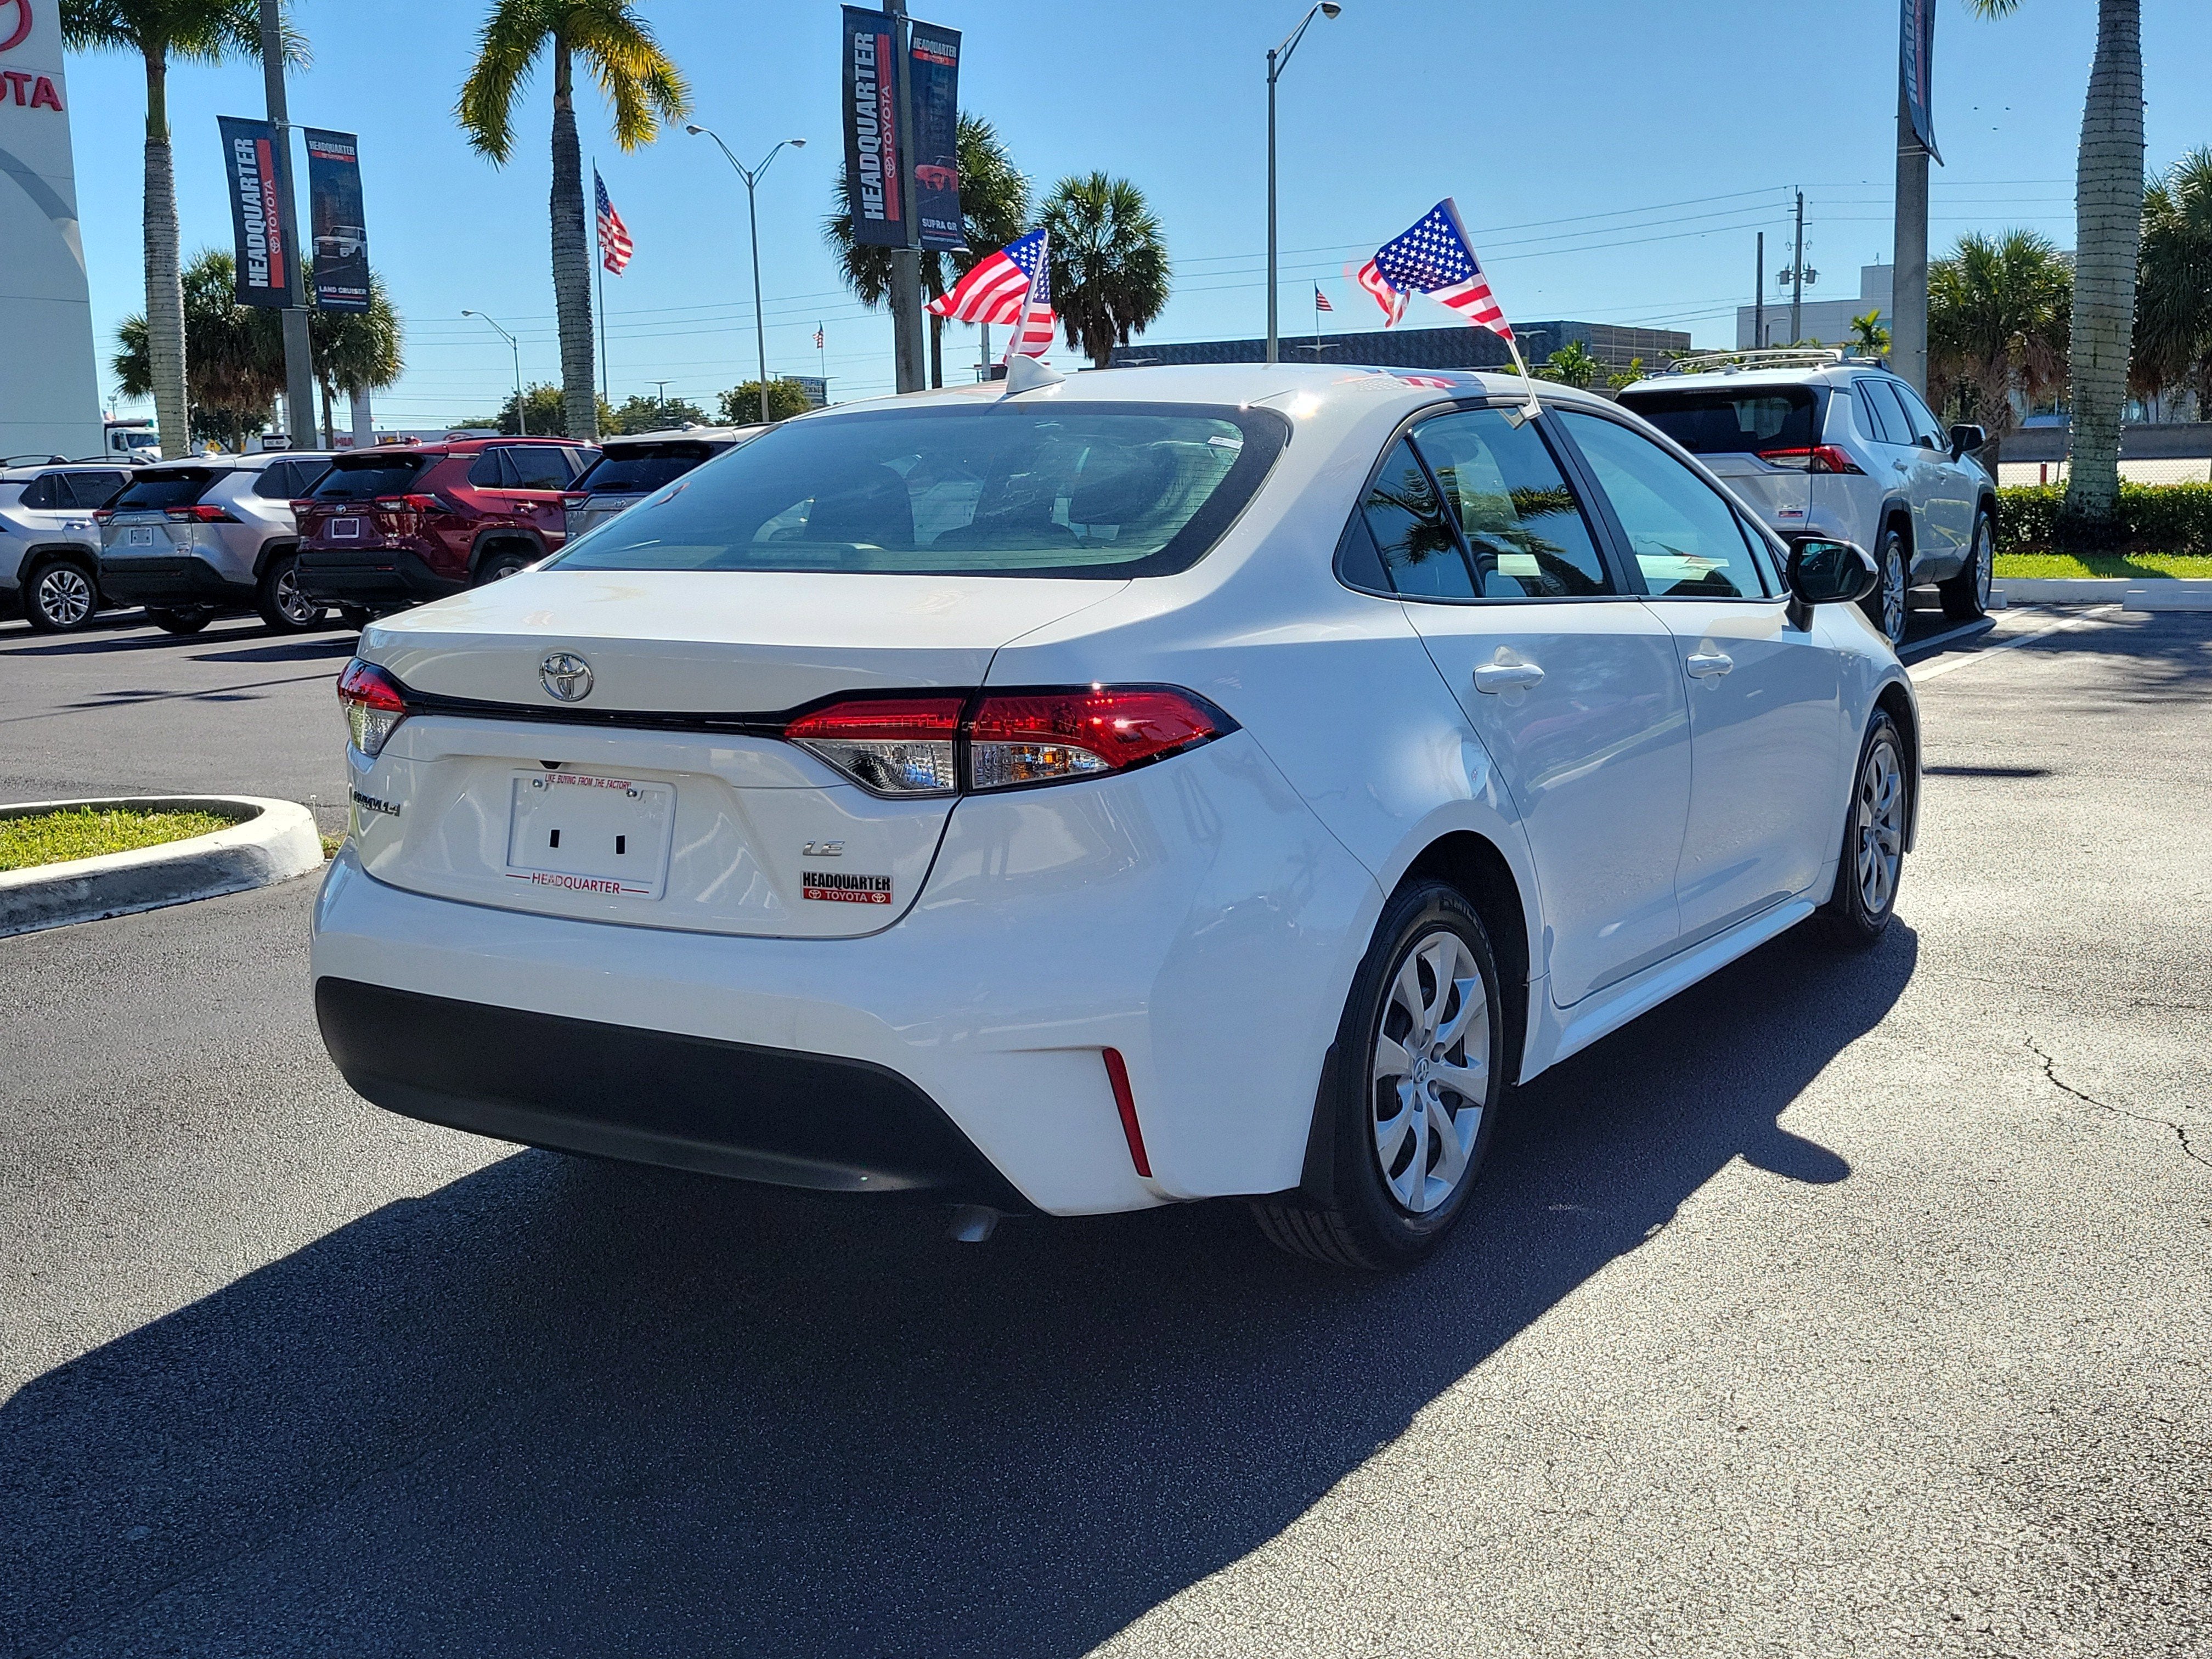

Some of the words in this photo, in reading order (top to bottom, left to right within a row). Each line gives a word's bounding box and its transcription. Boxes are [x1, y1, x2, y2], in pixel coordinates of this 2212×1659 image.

[912, 37, 956, 58] HEADQUARTER
[854, 32, 884, 221] HEADQUARTER
[881, 86, 894, 154] TOYOTA
[309, 140, 356, 156] HEADQUARTER
[234, 138, 268, 288] HEADQUARTER
[264, 180, 278, 235] TOYOTA
[922, 218, 946, 230] SUPRA
[946, 221, 957, 232] GR
[545, 774, 556, 783] LIKE
[557, 775, 576, 785] BUYING
[577, 776, 594, 787] FROM
[594, 778, 605, 788] THE
[803, 840, 845, 856] LE
[532, 872, 620, 894] HEADQUARTER
[803, 872, 890, 891] HEADQUARTER
[825, 891, 868, 902] TOYOTA
